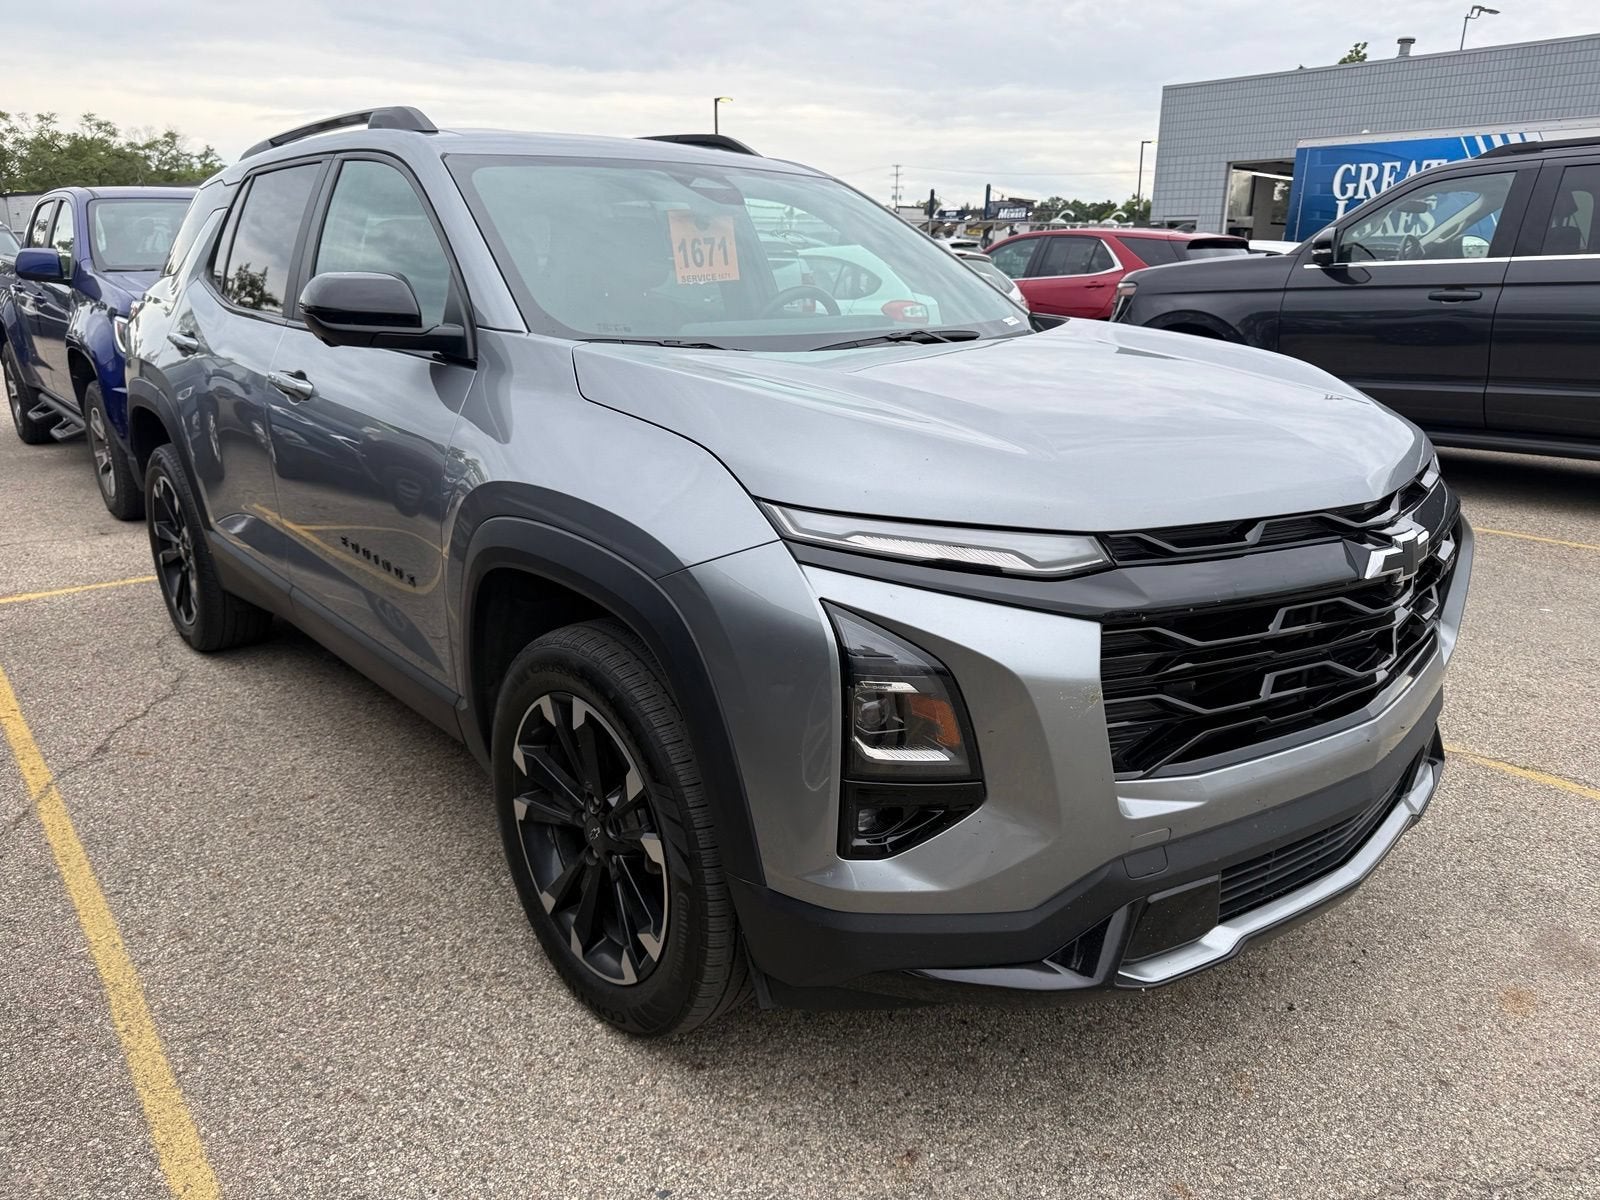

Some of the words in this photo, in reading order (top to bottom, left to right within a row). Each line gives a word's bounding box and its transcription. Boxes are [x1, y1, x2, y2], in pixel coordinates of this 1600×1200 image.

[1333, 159, 1448, 200] GRE
[678, 236, 729, 268] 1671
[681, 273, 717, 283] SERVICE
